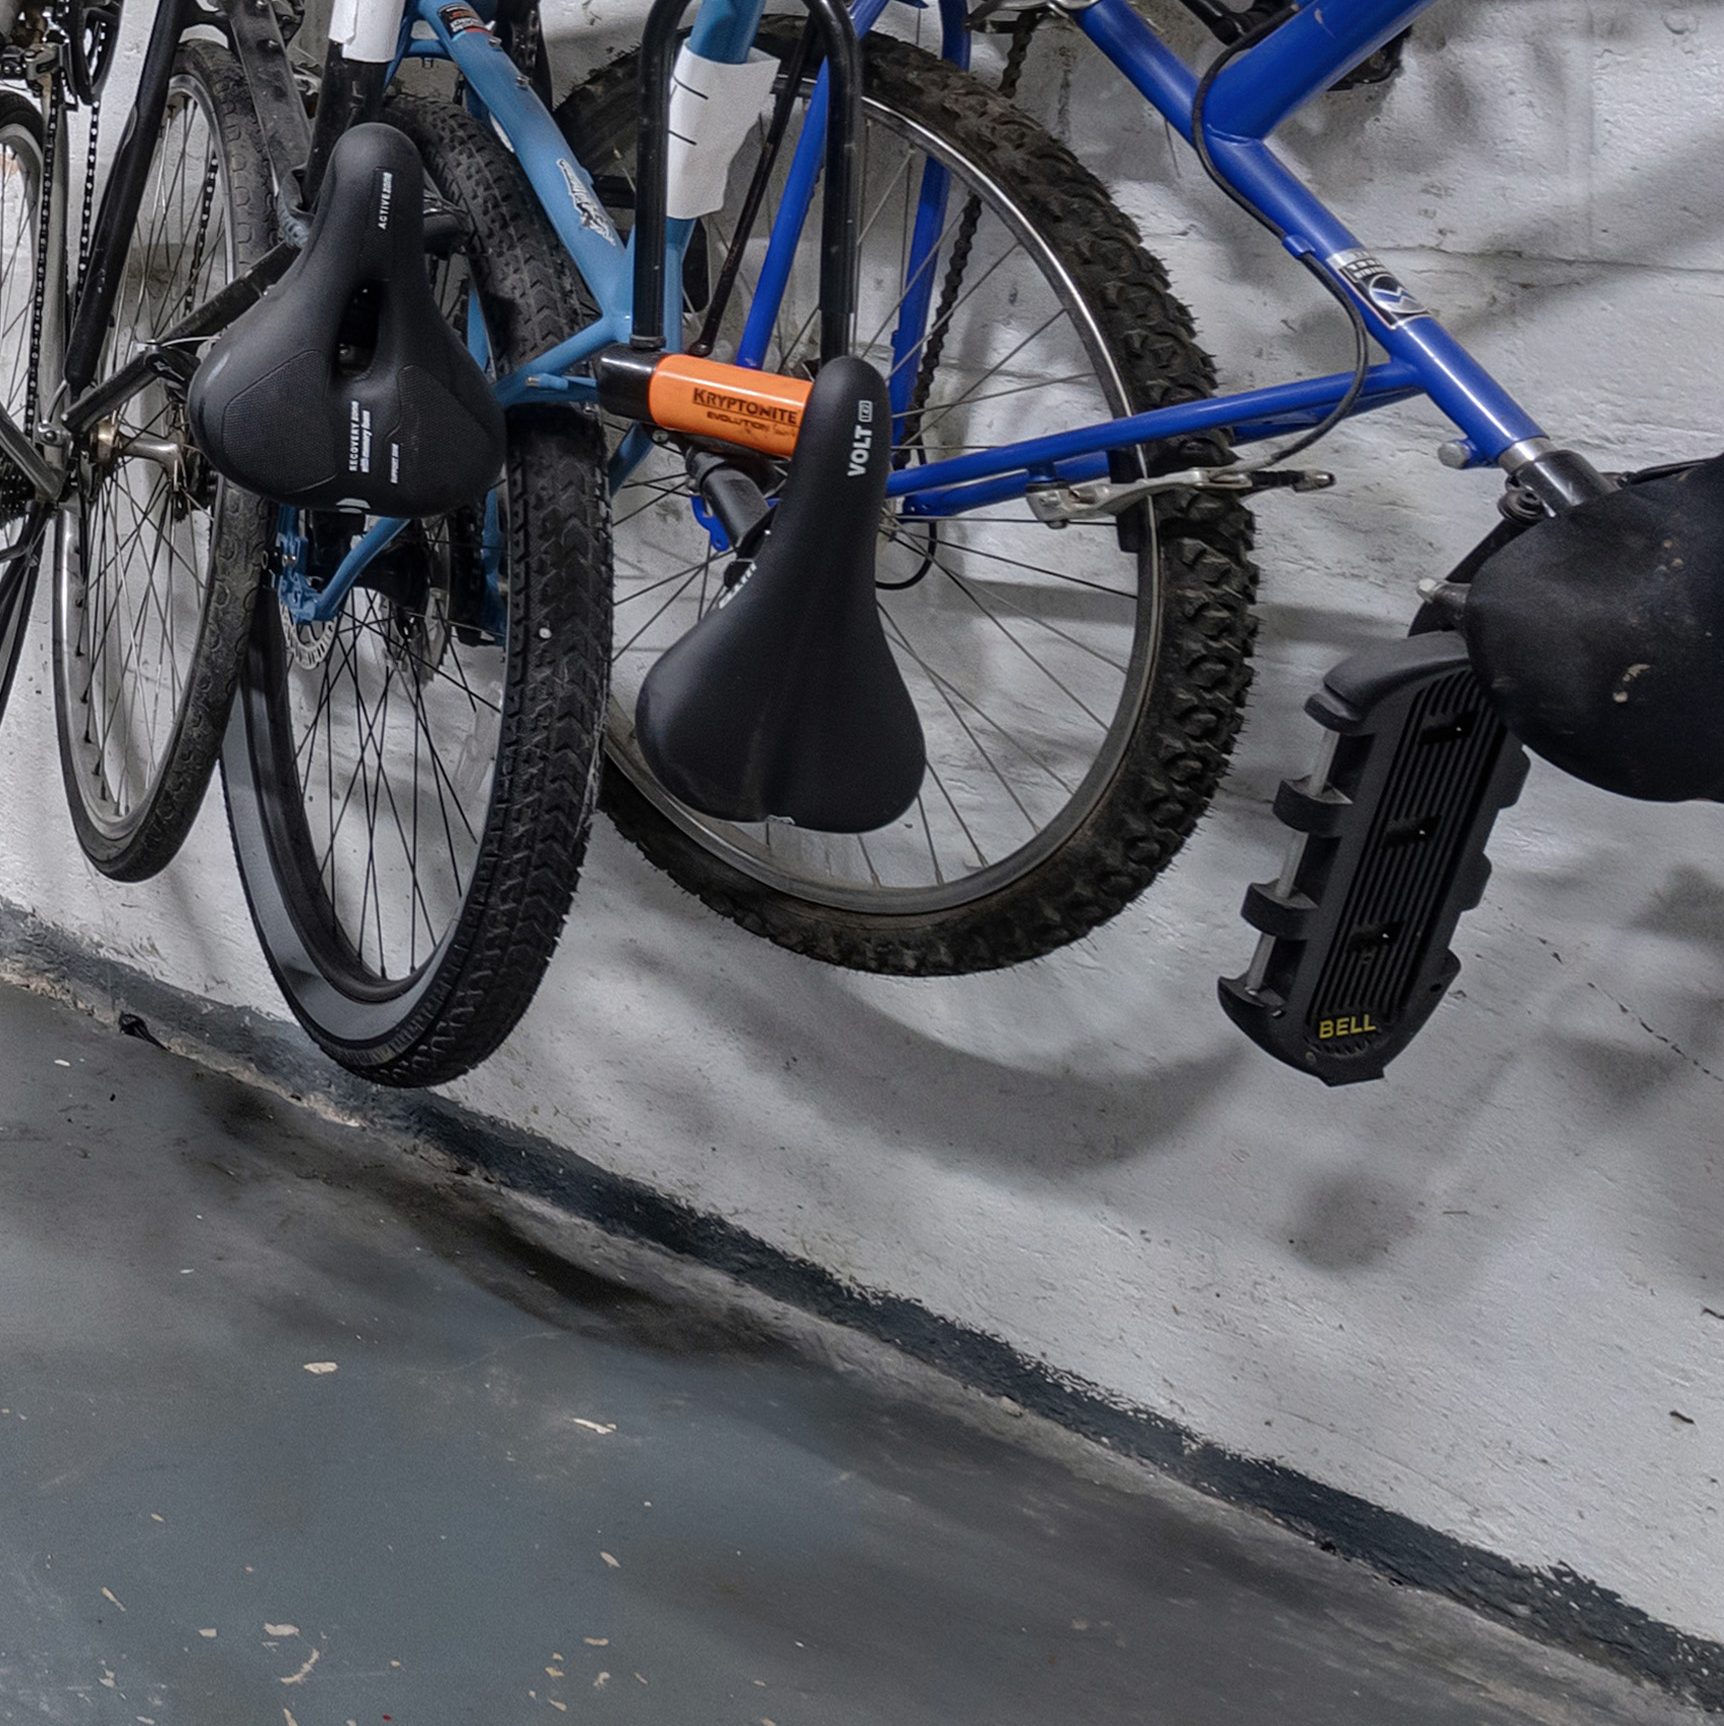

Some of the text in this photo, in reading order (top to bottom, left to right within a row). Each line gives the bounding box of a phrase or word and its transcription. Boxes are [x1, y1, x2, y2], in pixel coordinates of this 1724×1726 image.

[377, 193, 390, 230] ACTIVE
[692, 387, 799, 425] KRYPTONITE
[706, 411, 772, 431] EVOLUTION
[349, 423, 359, 472] RECOVERY
[847, 425, 872, 477] VOLT
[1318, 1013, 1378, 1040] BELL
